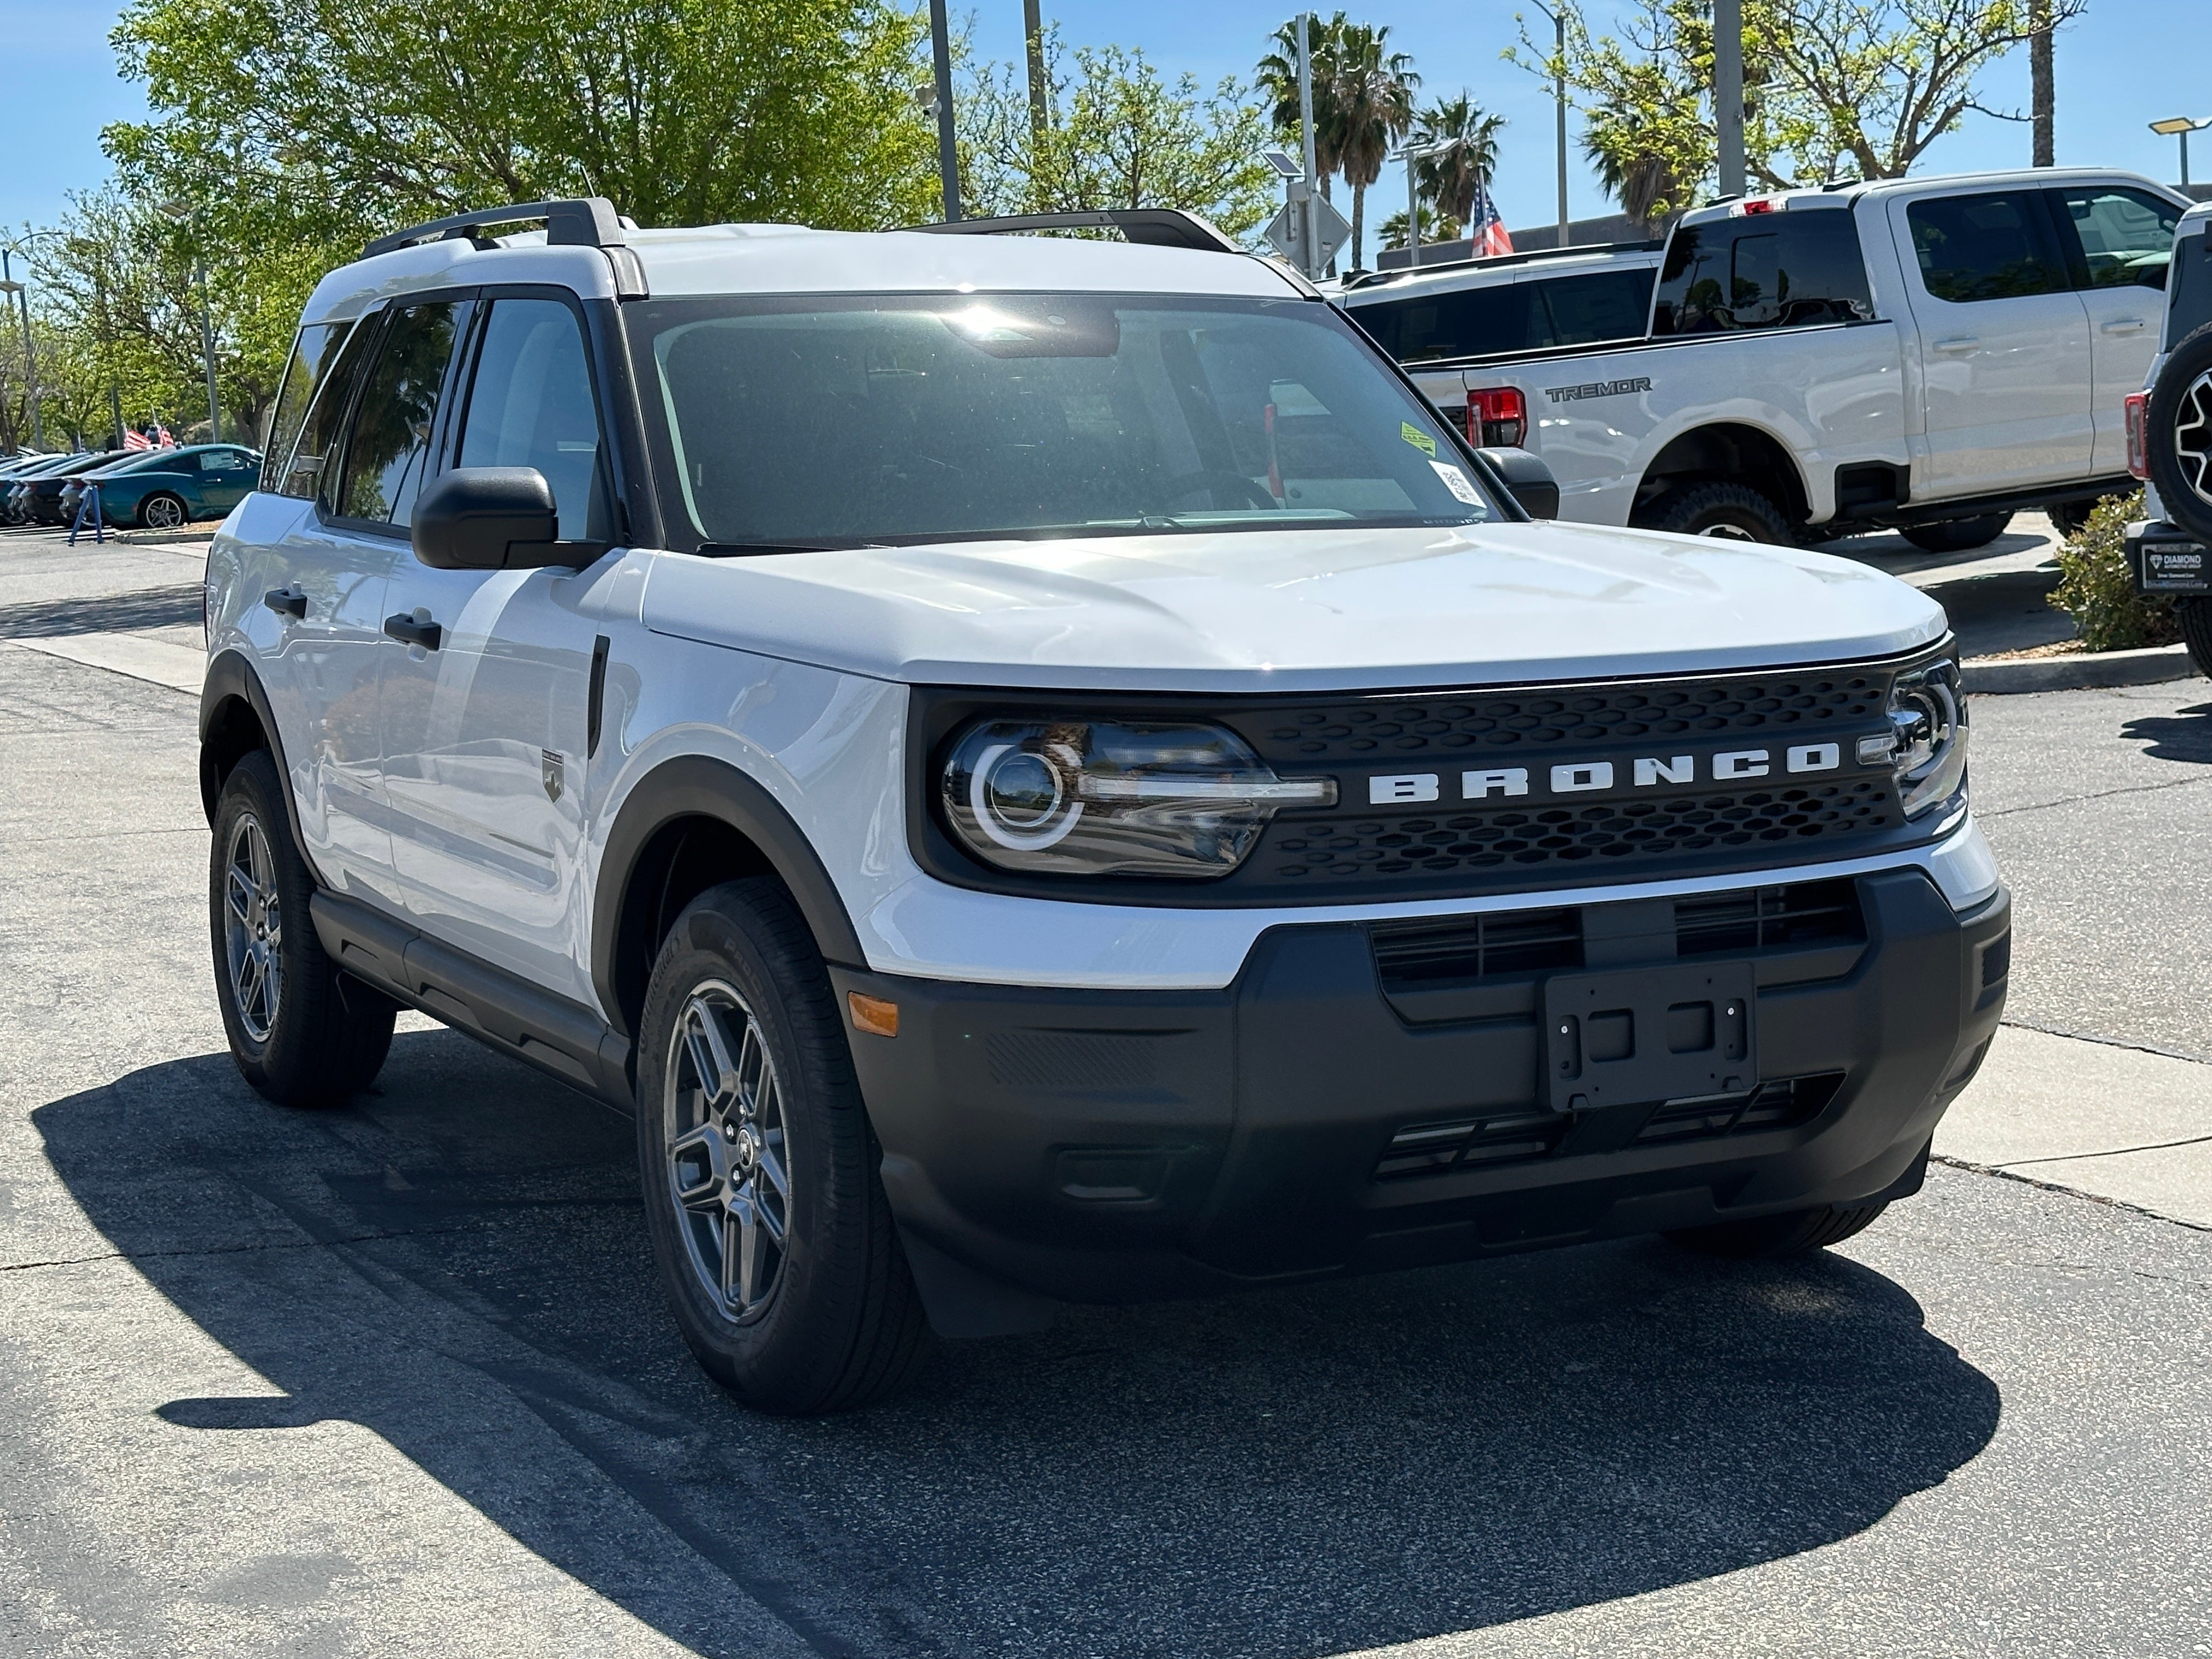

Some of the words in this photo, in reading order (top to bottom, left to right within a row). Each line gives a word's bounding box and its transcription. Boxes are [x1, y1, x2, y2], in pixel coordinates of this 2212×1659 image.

[1545, 377, 1653, 403] TREMOR
[2164, 554, 2201, 564] DIAMOND
[1369, 743, 1839, 804] BRONCO
